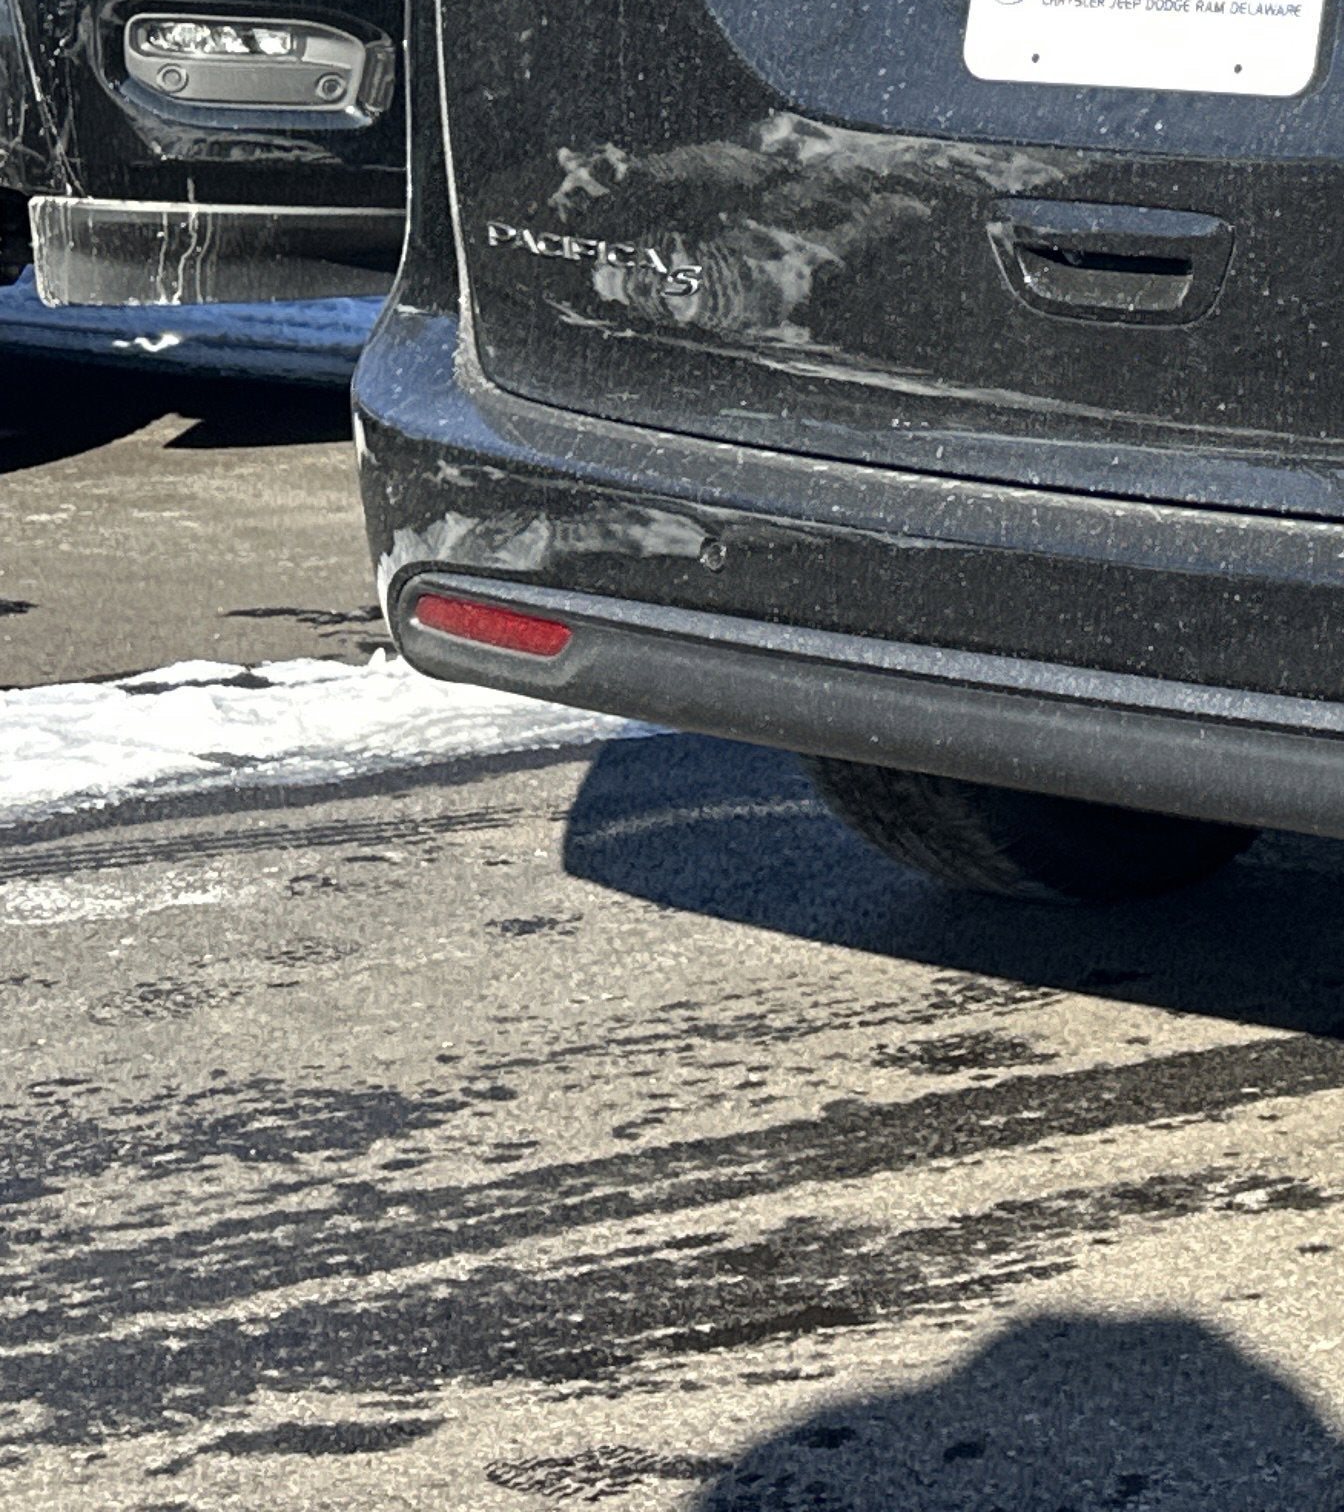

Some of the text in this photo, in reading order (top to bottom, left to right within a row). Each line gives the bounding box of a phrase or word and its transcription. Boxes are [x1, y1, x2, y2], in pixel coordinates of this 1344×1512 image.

[1195, 0, 1225, 14] RAM
[1229, 1, 1302, 17] DELAWARE
[487, 221, 668, 274] PACIFICA
